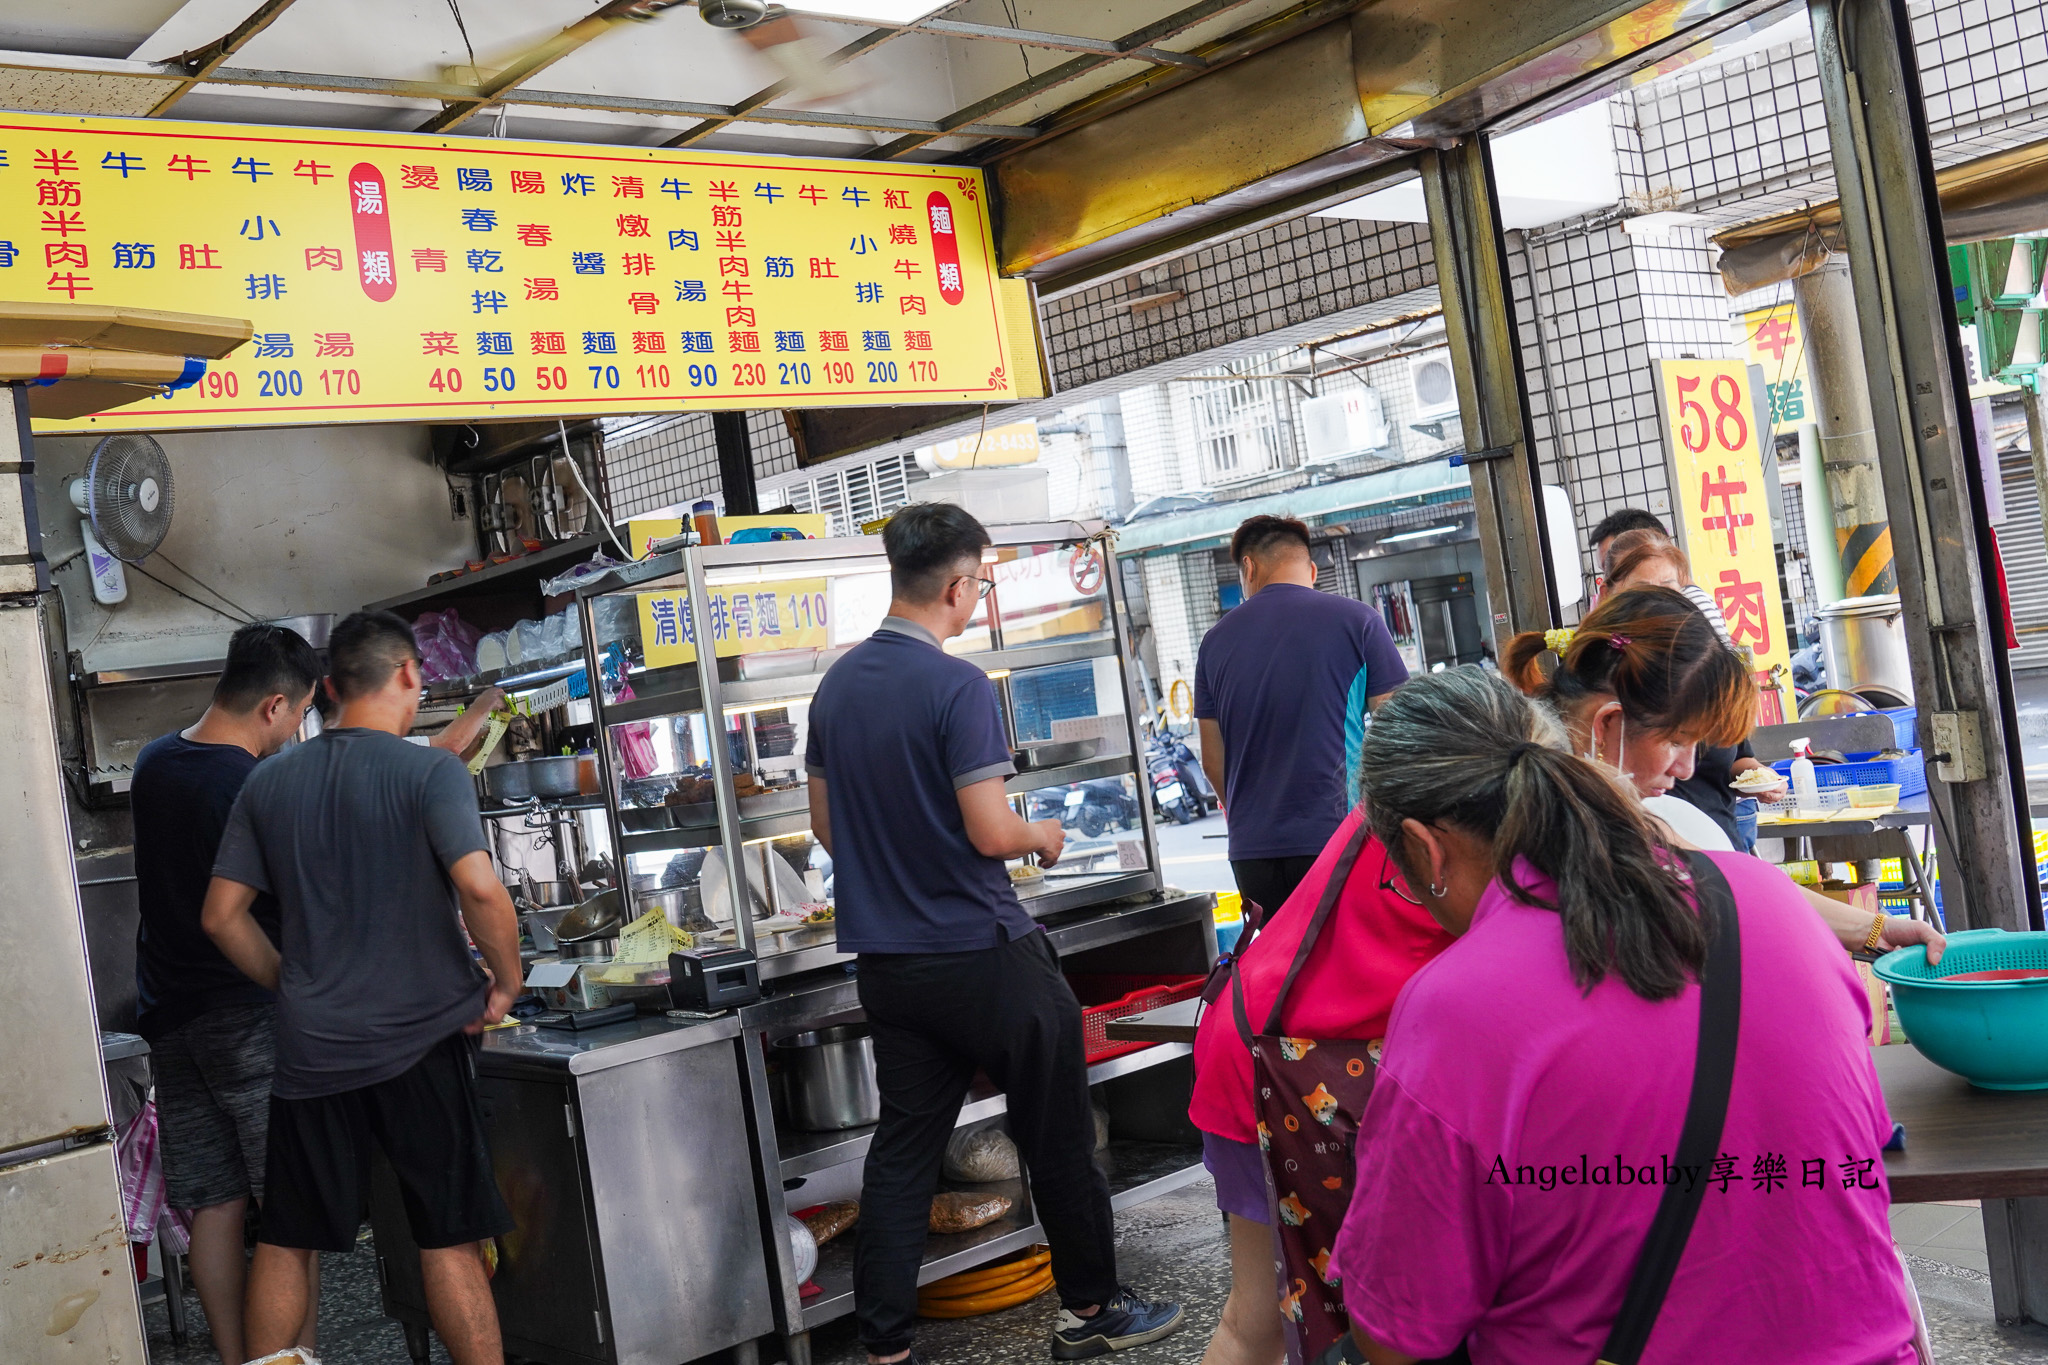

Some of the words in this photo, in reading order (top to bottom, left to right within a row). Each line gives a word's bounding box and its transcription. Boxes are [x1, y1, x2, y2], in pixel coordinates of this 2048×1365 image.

[32, 148, 95, 305] 半筋半肉牛
[231, 157, 294, 358] 牛小排湯
[292, 159, 355, 358] 牛肉湯
[353, 179, 394, 288] 湯類
[929, 204, 964, 295] 麵類
[399, 164, 460, 357] 燙青菜
[456, 167, 514, 356] 陽春乾拌麵
[509, 170, 568, 355] 陽春湯麵
[561, 172, 617, 355] 炸醬麵
[611, 175, 667, 354] 清燉排骨麵
[660, 178, 714, 353] 牛肉湯麵
[708, 180, 761, 353] 半筋半肉牛肉麵
[754, 182, 805, 352] 牛筋麵
[798, 184, 850, 352] 牛肚麵
[842, 186, 892, 351] 牛小排麵
[882, 188, 933, 351] 紅燒牛肉麵
[868, 362, 897, 382] 200
[909, 361, 937, 381] 170
[1755, 318, 1796, 360] 牛
[198, 371, 238, 398] 190
[258, 370, 302, 396] 200
[320, 369, 360, 395] 170
[429, 368, 462, 392] 40
[485, 368, 514, 391] 50
[537, 367, 567, 390] 50
[589, 366, 619, 388] 70
[637, 365, 669, 387] 110
[689, 365, 716, 386] 90
[733, 364, 765, 385] 230
[779, 363, 810, 384] 210
[823, 362, 854, 383] 190
[787, 593, 828, 630] 110
